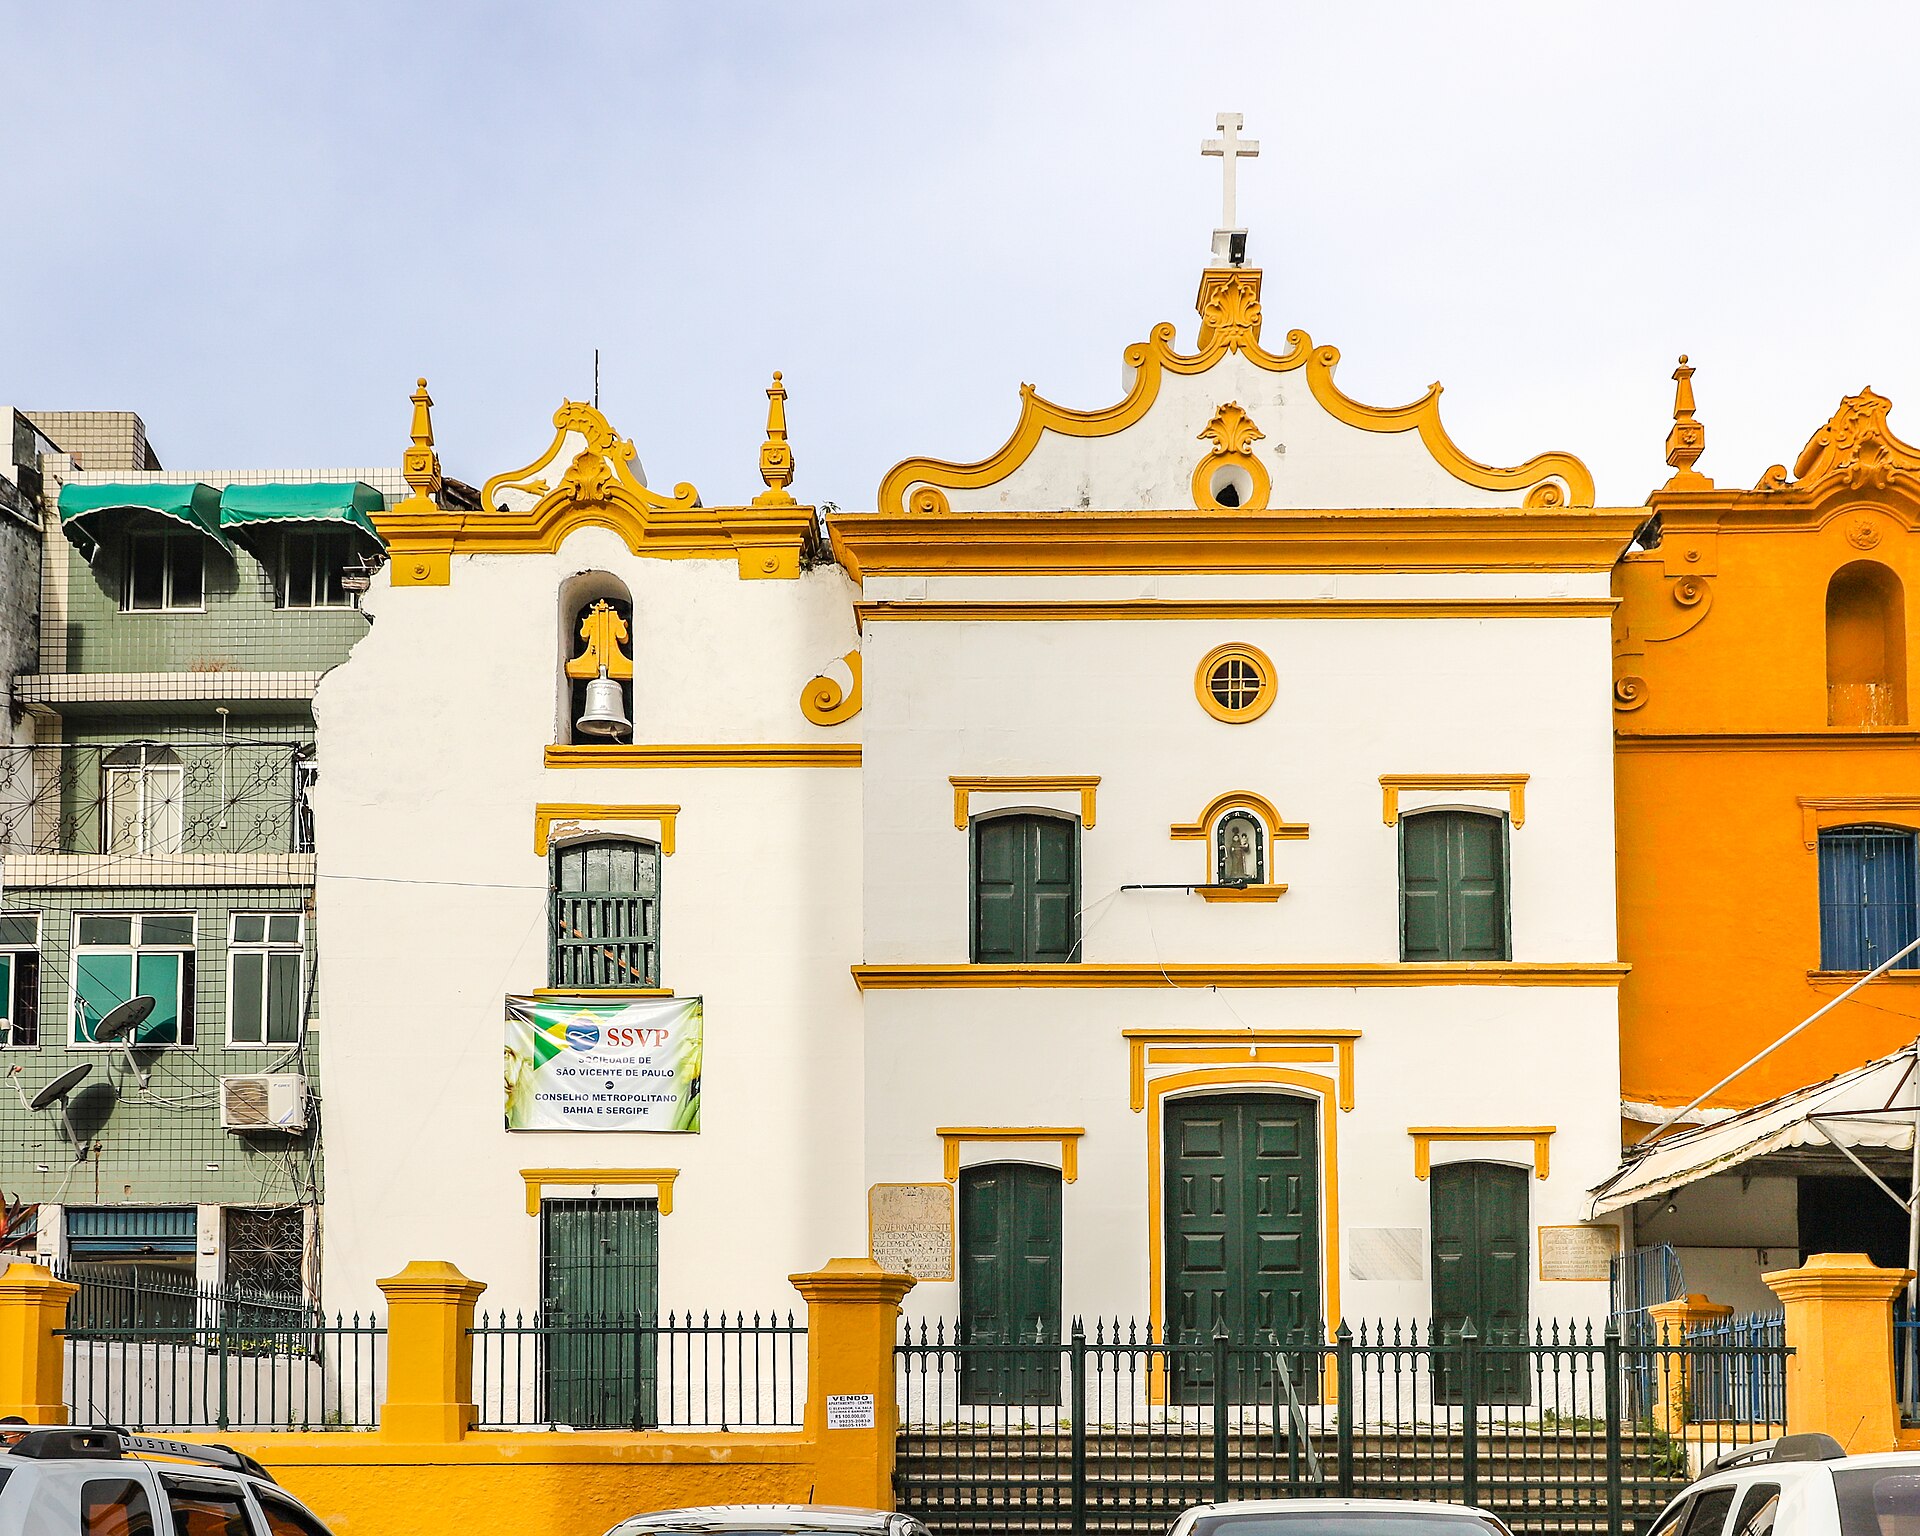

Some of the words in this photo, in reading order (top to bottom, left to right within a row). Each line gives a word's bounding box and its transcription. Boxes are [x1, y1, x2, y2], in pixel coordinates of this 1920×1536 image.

[607, 1028, 669, 1048] SSVP
[638, 1056, 652, 1064] DE
[556, 1067, 576, 1077] SÃO
[579, 1069, 622, 1077] VICENTE
[625, 1069, 639, 1077] DE
[641, 1069, 675, 1078] PAULO
[535, 1093, 590, 1102] CONSELHO
[592, 1093, 678, 1103] METROPOLITANO
[563, 1106, 594, 1115] BAHIA
[596, 1106, 603, 1115] E
[606, 1106, 649, 1115] SERGIPE
[121, 1437, 190, 1454] DUSTER
